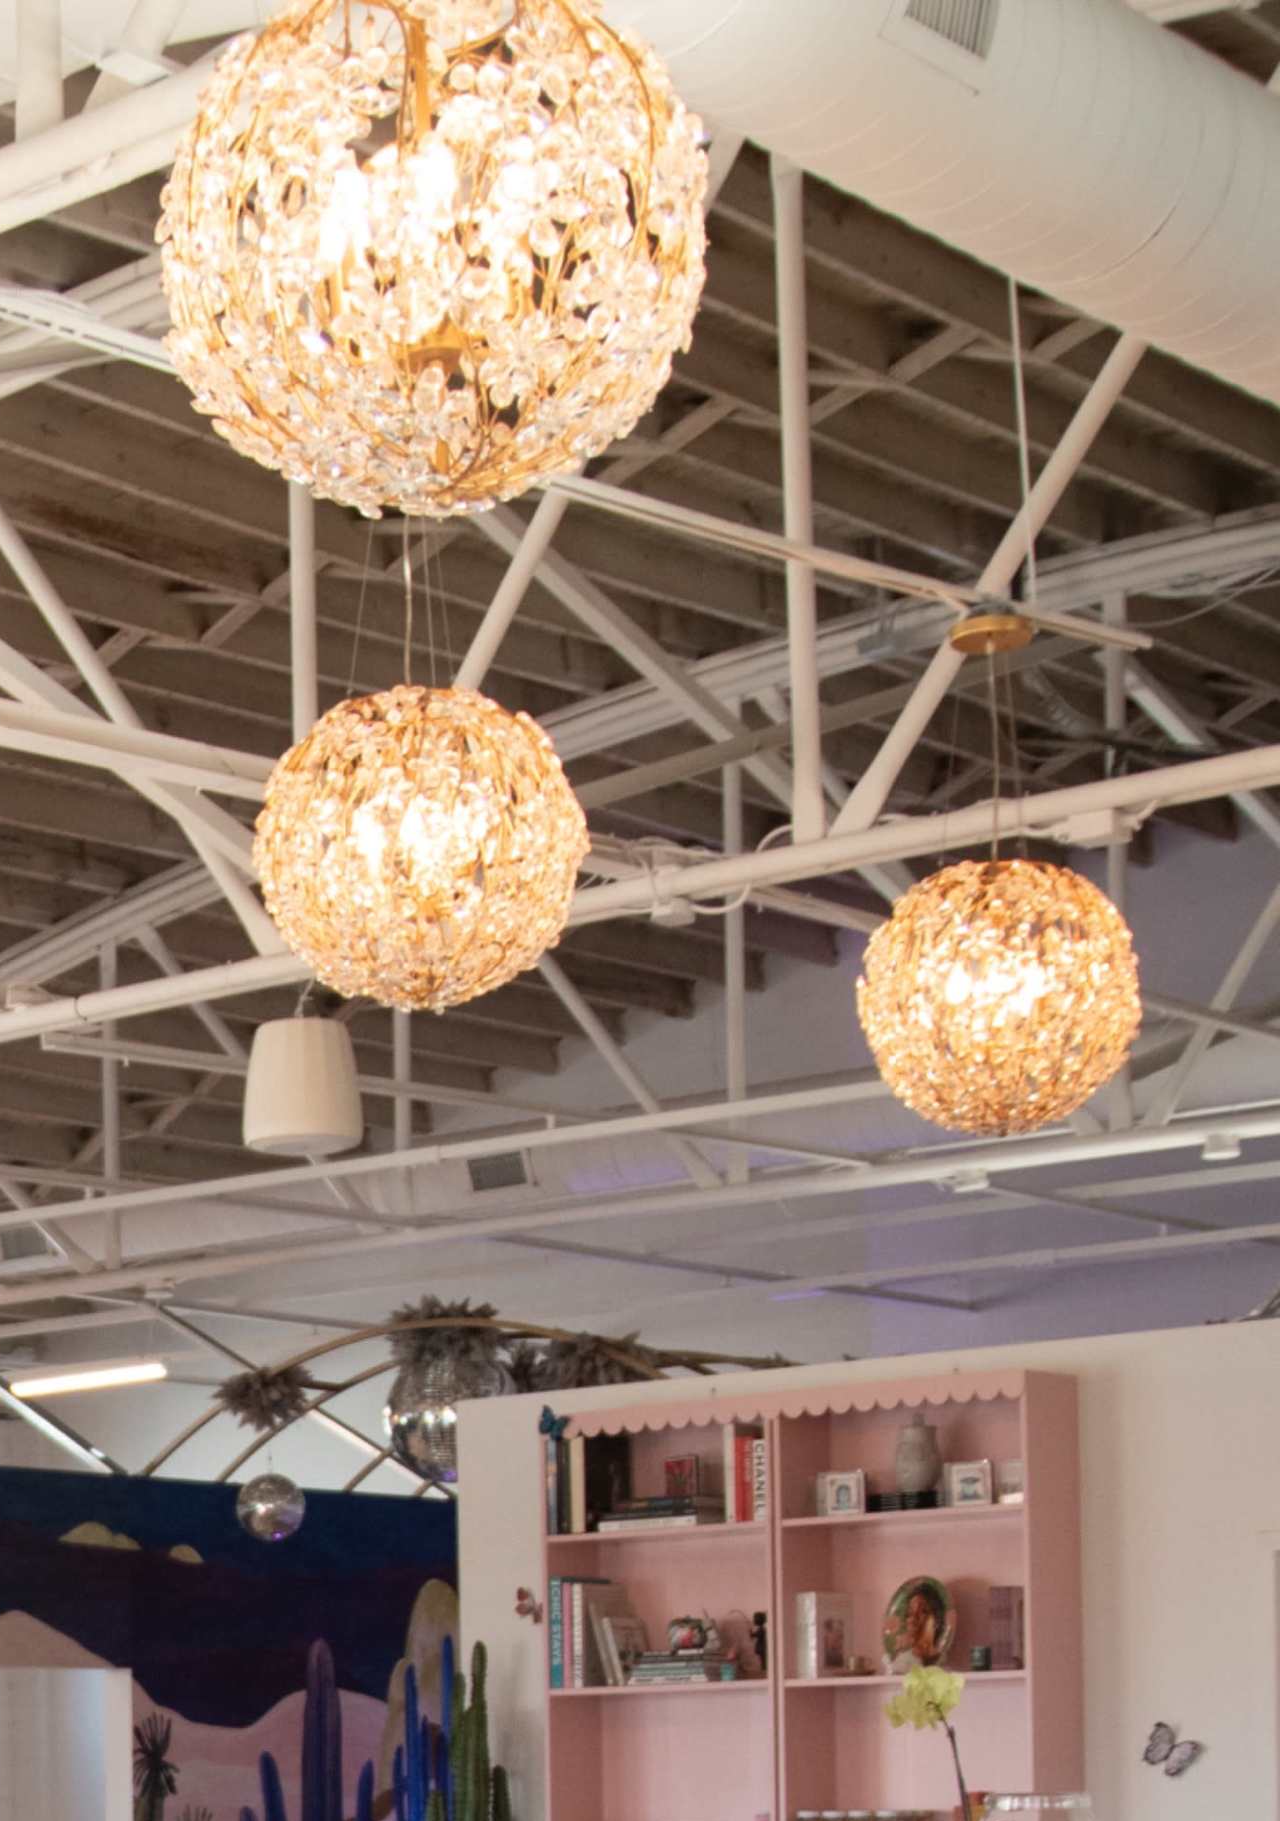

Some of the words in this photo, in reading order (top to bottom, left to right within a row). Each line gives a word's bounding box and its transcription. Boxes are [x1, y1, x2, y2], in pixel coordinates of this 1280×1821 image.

[755, 1443, 766, 1511] CHANEL
[551, 1587, 561, 1618] CHIC
[551, 1623, 561, 1664] STAYS
